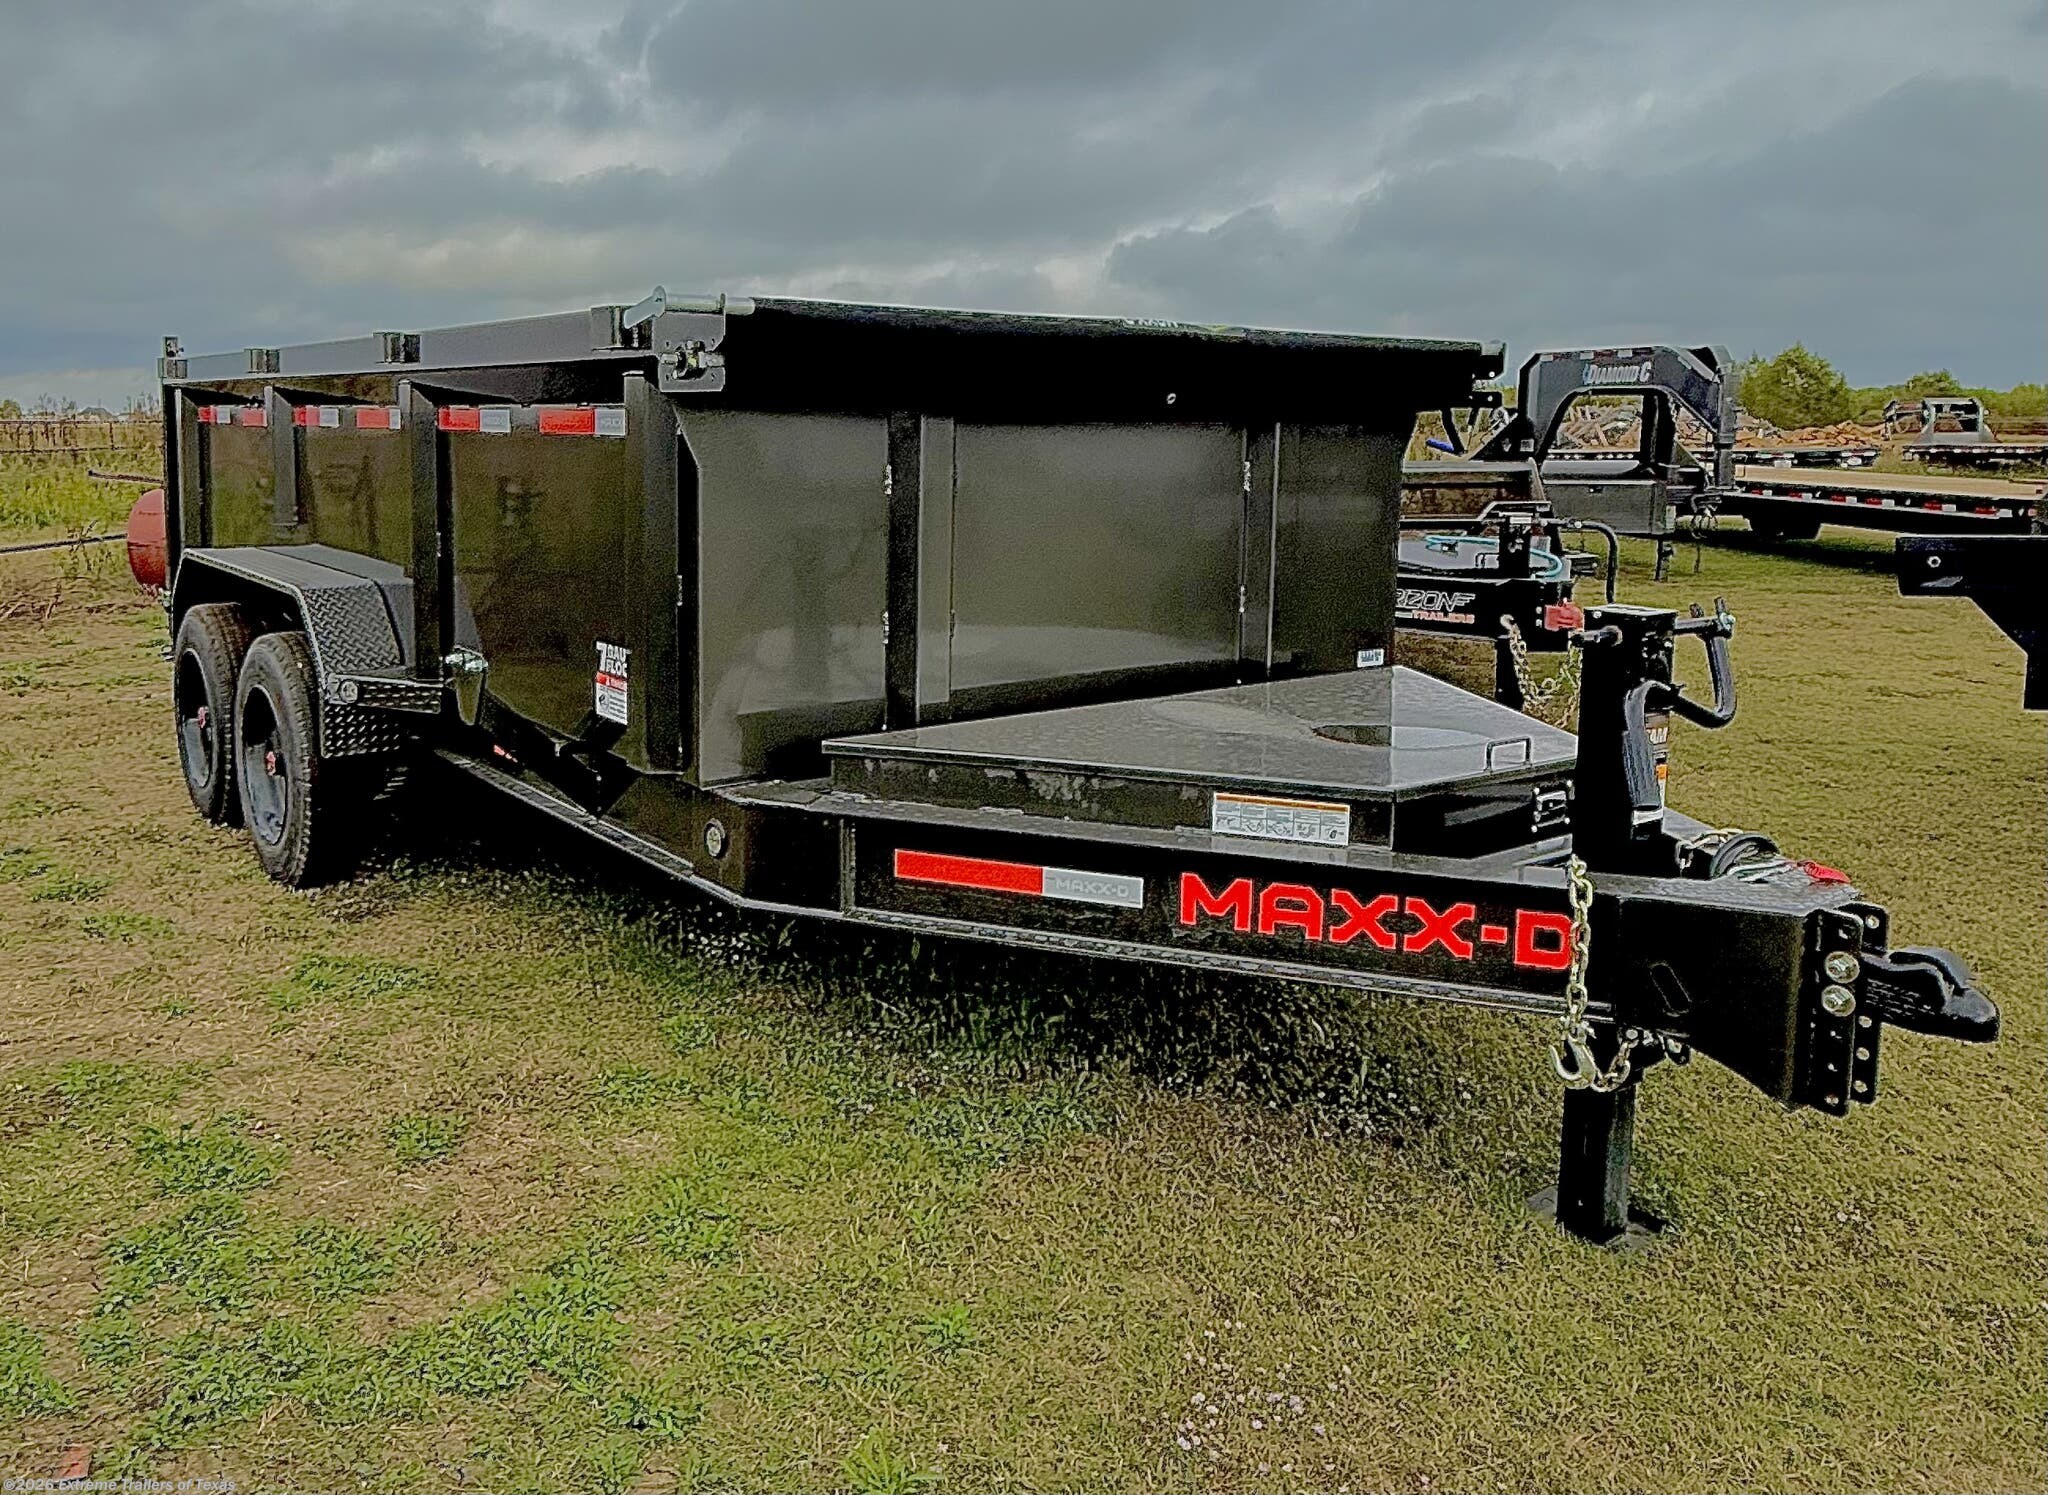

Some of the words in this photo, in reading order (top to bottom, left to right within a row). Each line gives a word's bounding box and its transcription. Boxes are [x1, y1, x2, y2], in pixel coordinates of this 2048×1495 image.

[1412, 609, 1475, 624] TRAILERS
[1055, 876, 1129, 898] MAXX-D
[1180, 872, 1577, 970] MAXX-D
